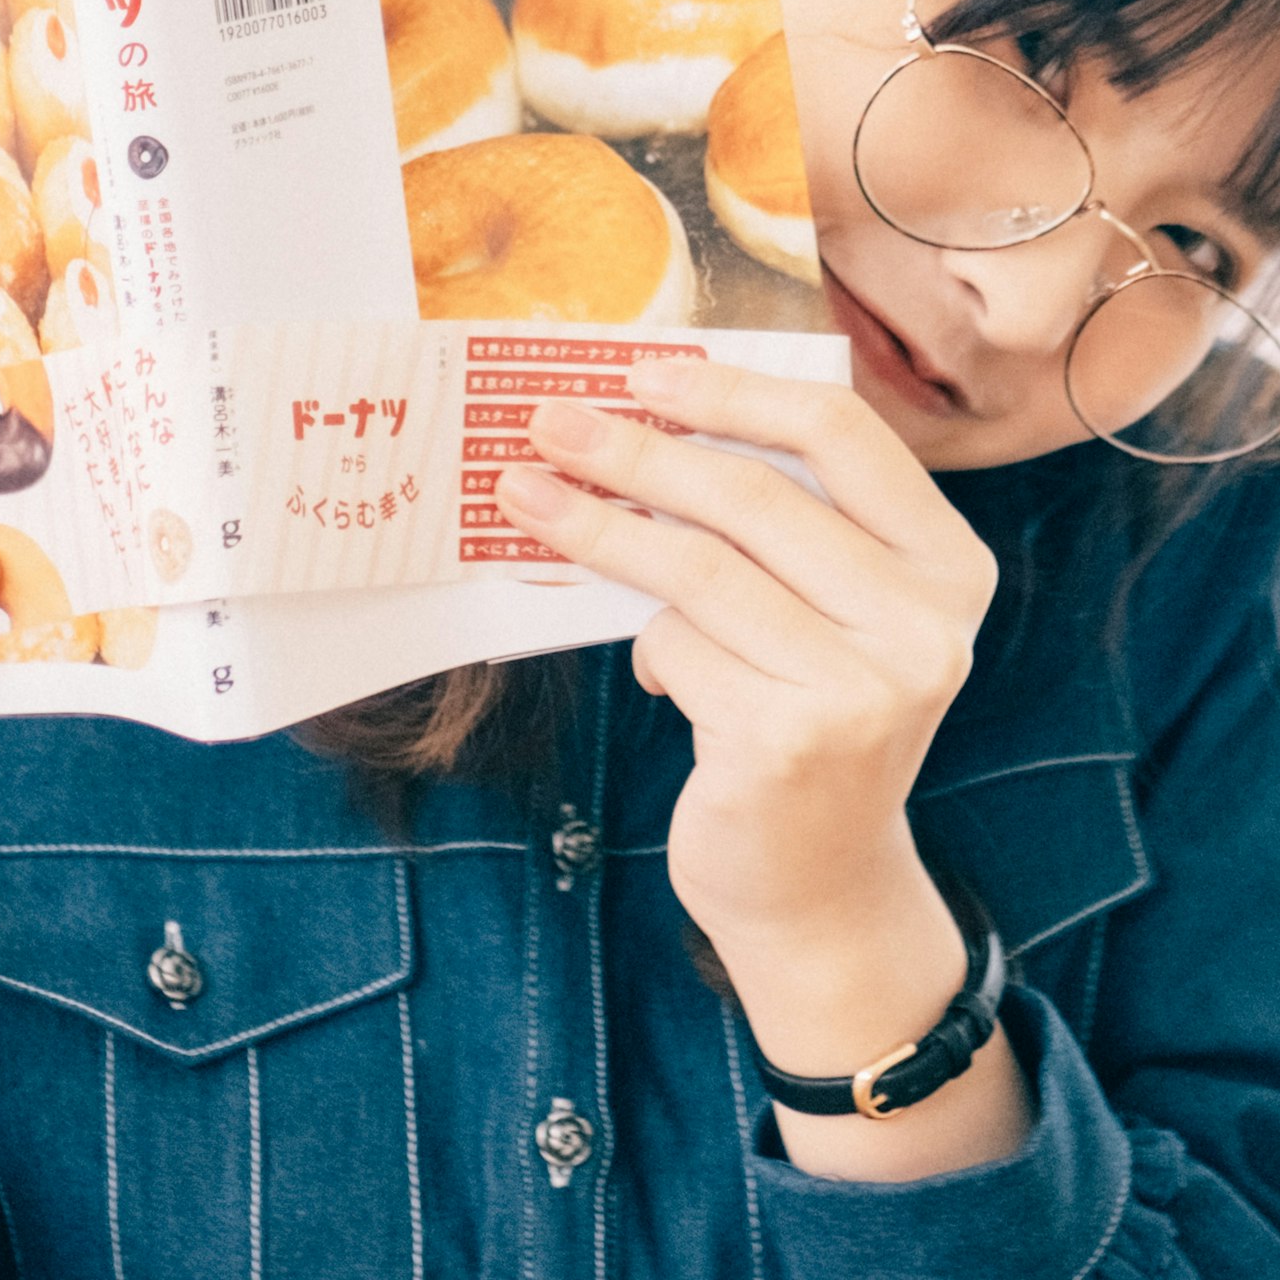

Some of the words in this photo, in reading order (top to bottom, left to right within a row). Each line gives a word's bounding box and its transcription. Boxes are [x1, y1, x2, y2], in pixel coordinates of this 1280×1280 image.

[219, 4, 328, 42] 1920077016003
[135, 348, 176, 446] みんな
[471, 376, 587, 393] 東京のドーナツ店
[599, 381, 625, 393] ドー
[112, 361, 151, 492] こんなに
[211, 386, 233, 477] 溝呂木一美
[292, 398, 408, 441] ドーナツ
[341, 454, 367, 474] から
[286, 473, 420, 530] ふくらむ幸せ
[463, 543, 558, 558] 食べに食べた
